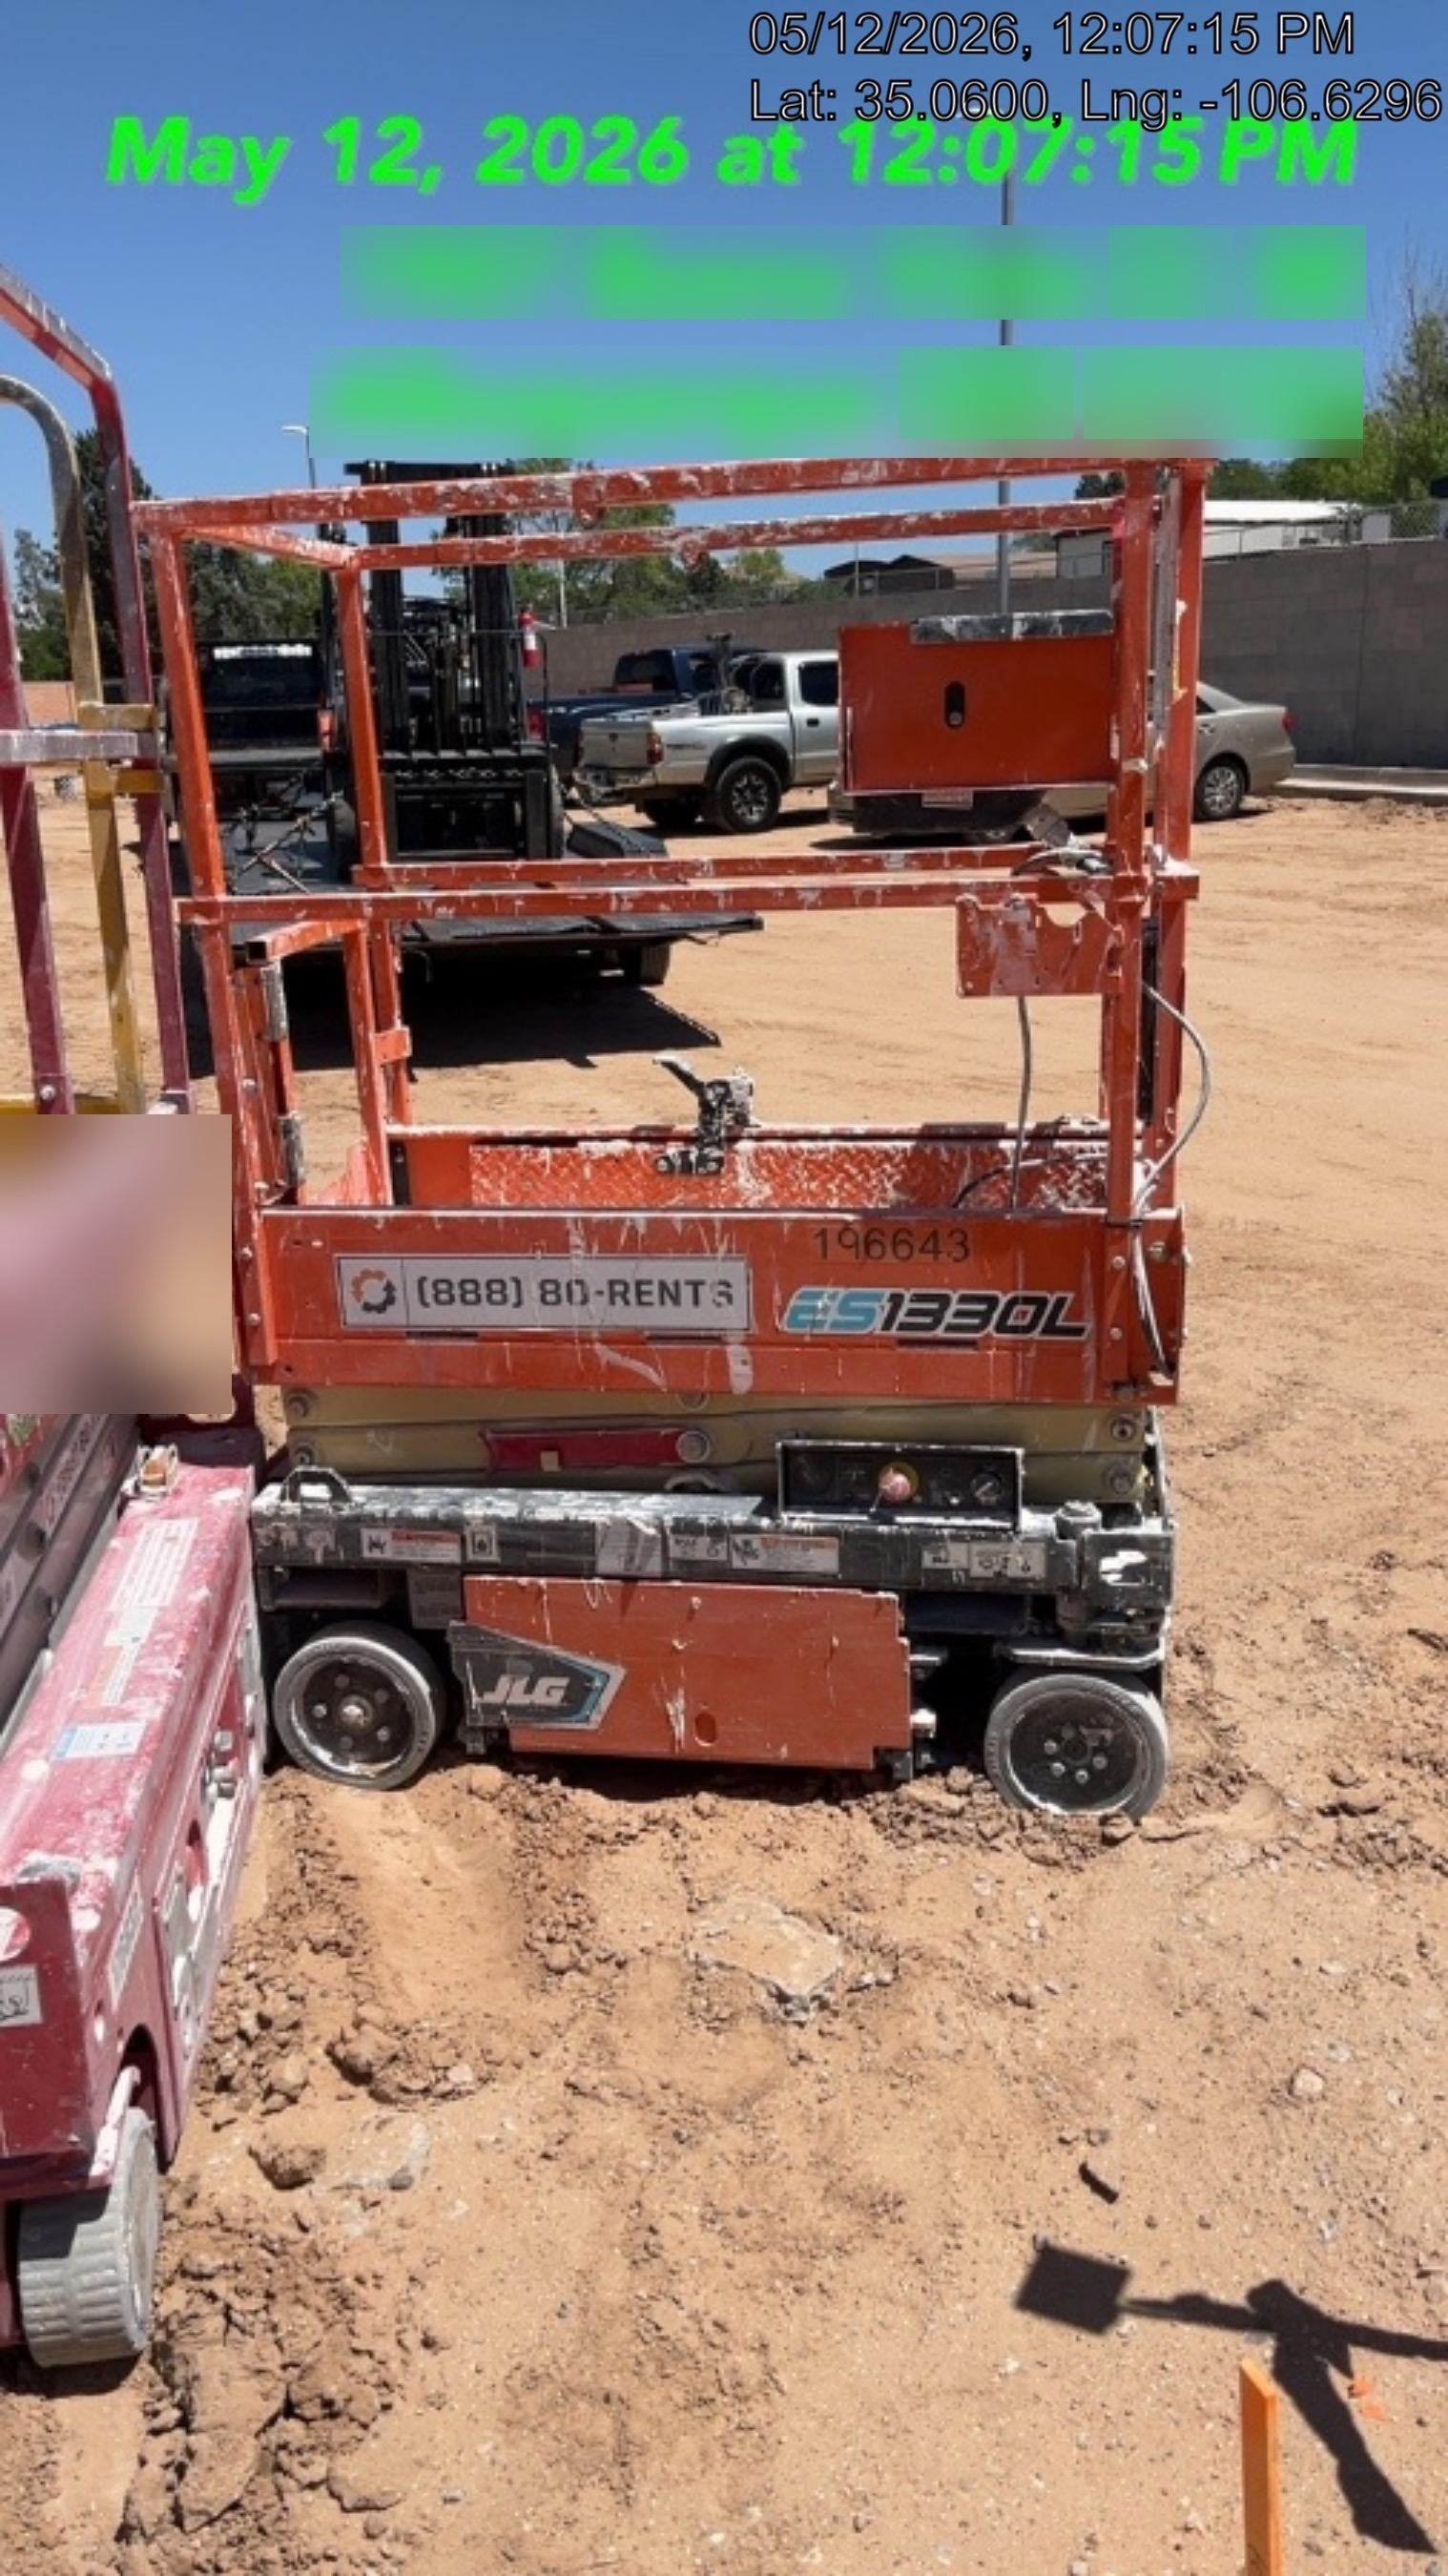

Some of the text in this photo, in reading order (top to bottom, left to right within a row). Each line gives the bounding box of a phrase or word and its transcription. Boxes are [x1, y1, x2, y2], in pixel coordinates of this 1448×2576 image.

[814, 1226, 971, 1263] 196643
[417, 1277, 734, 1308] (888) 80-RENTS
[783, 1287, 1092, 1339] ES1330L
[481, 1674, 570, 1706] JLG
